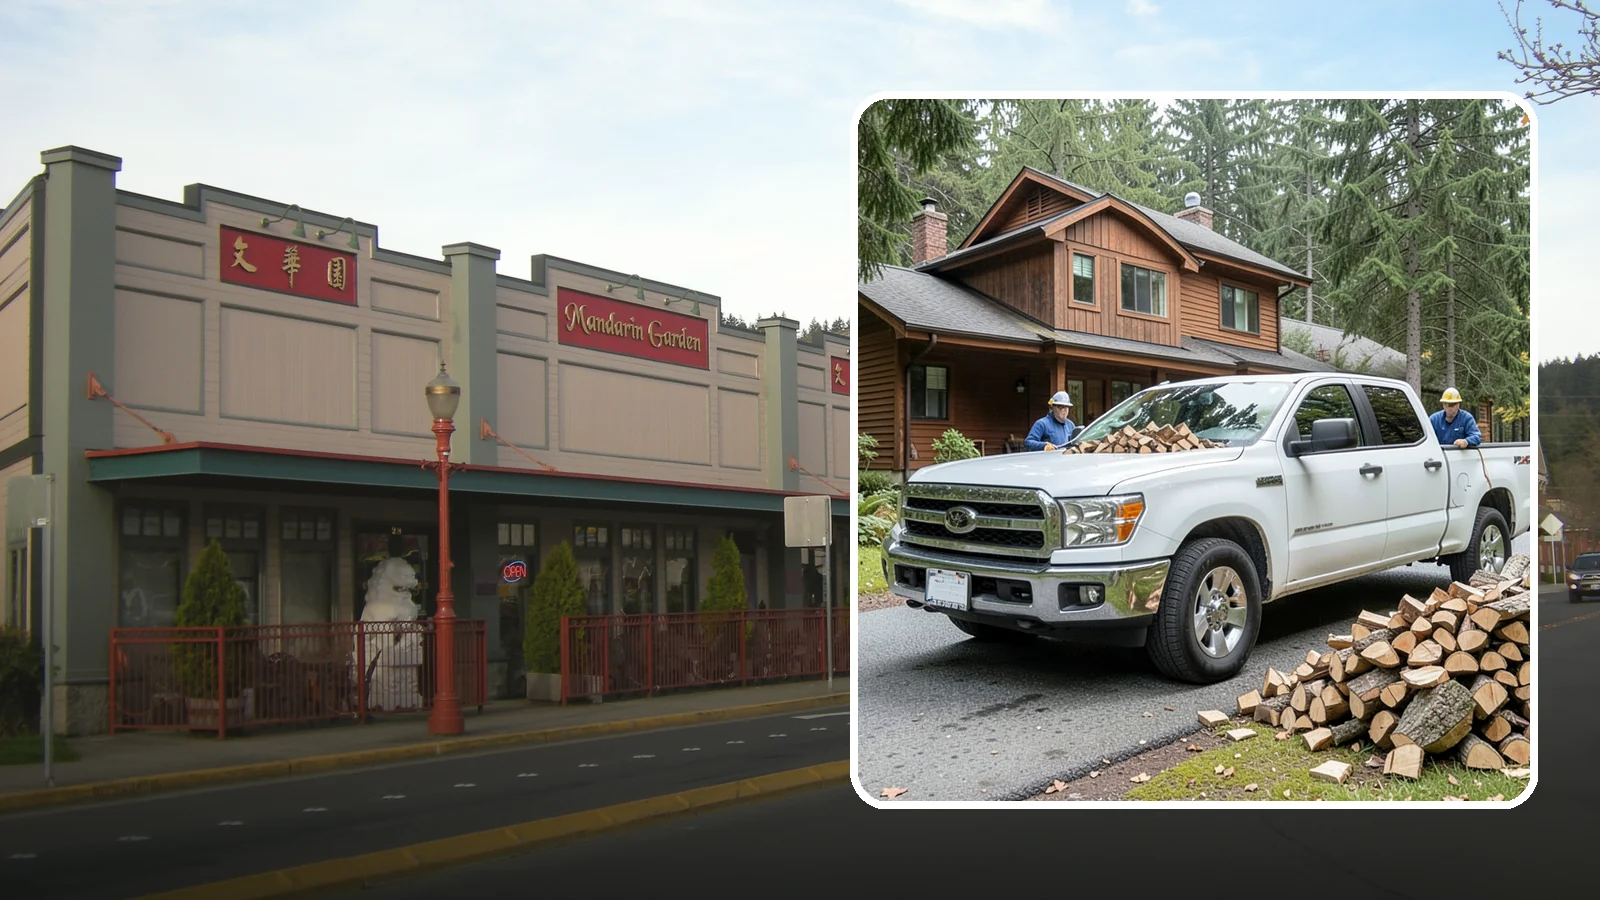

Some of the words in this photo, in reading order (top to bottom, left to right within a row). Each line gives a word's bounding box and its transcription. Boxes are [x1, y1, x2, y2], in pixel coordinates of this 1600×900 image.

[564, 302, 644, 340] Mandarin
[647, 320, 701, 352] Garden
[503, 565, 527, 578] OPEN
